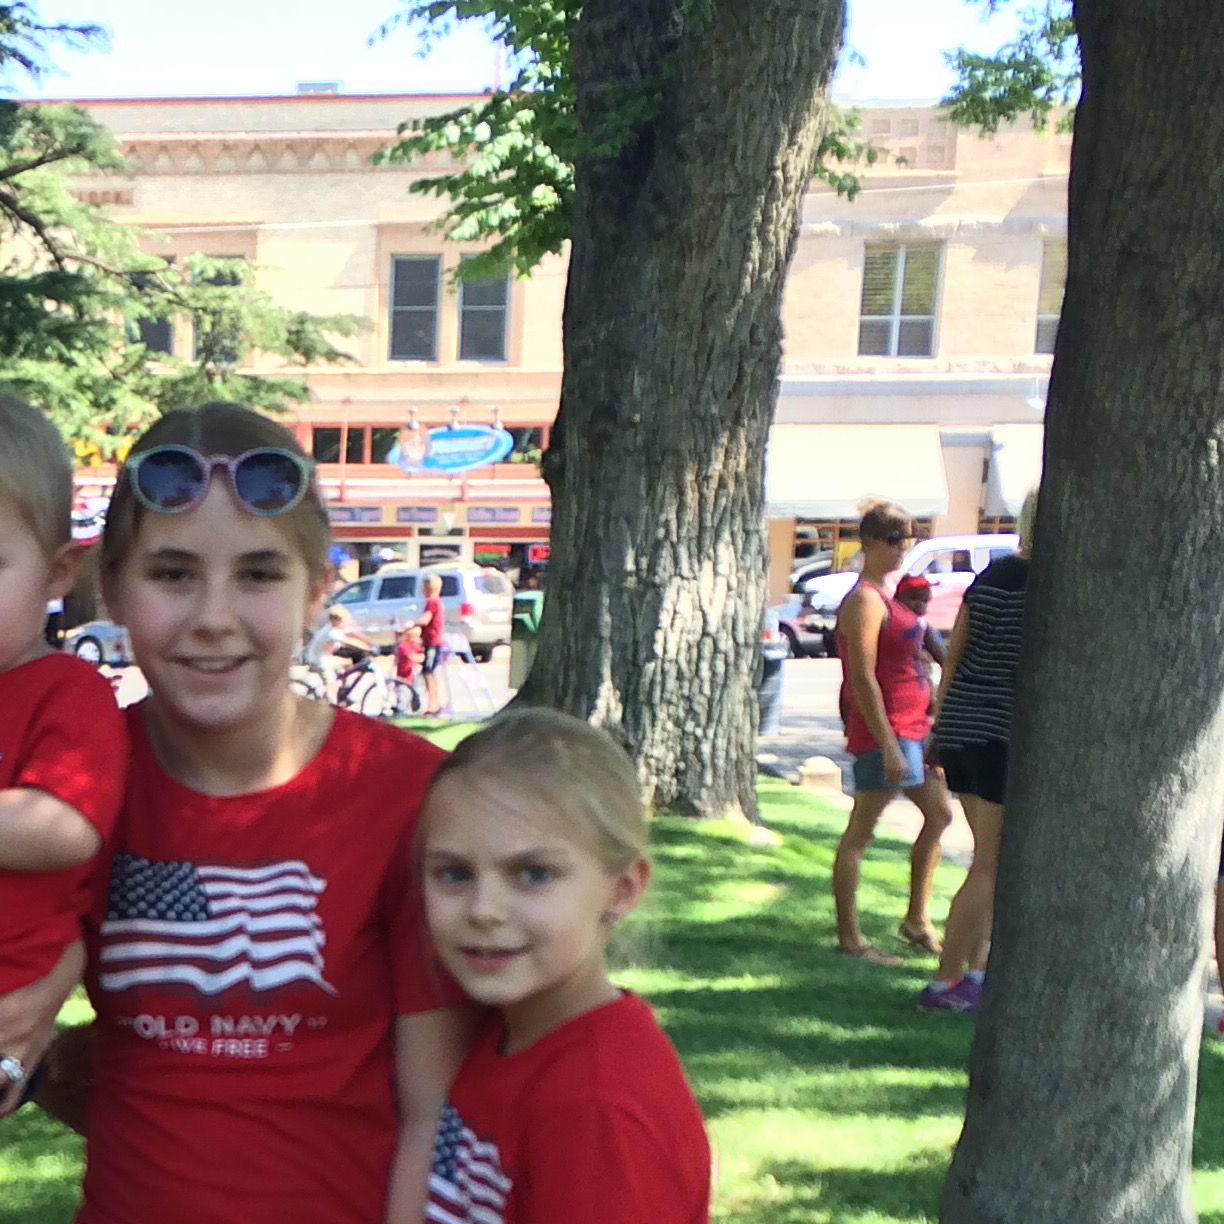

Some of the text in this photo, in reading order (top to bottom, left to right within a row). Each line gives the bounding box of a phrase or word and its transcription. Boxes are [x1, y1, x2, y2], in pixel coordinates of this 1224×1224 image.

[133, 1013, 199, 1039] OLD
[210, 1013, 301, 1036] NAVY
[211, 1038, 269, 1058] FREE
